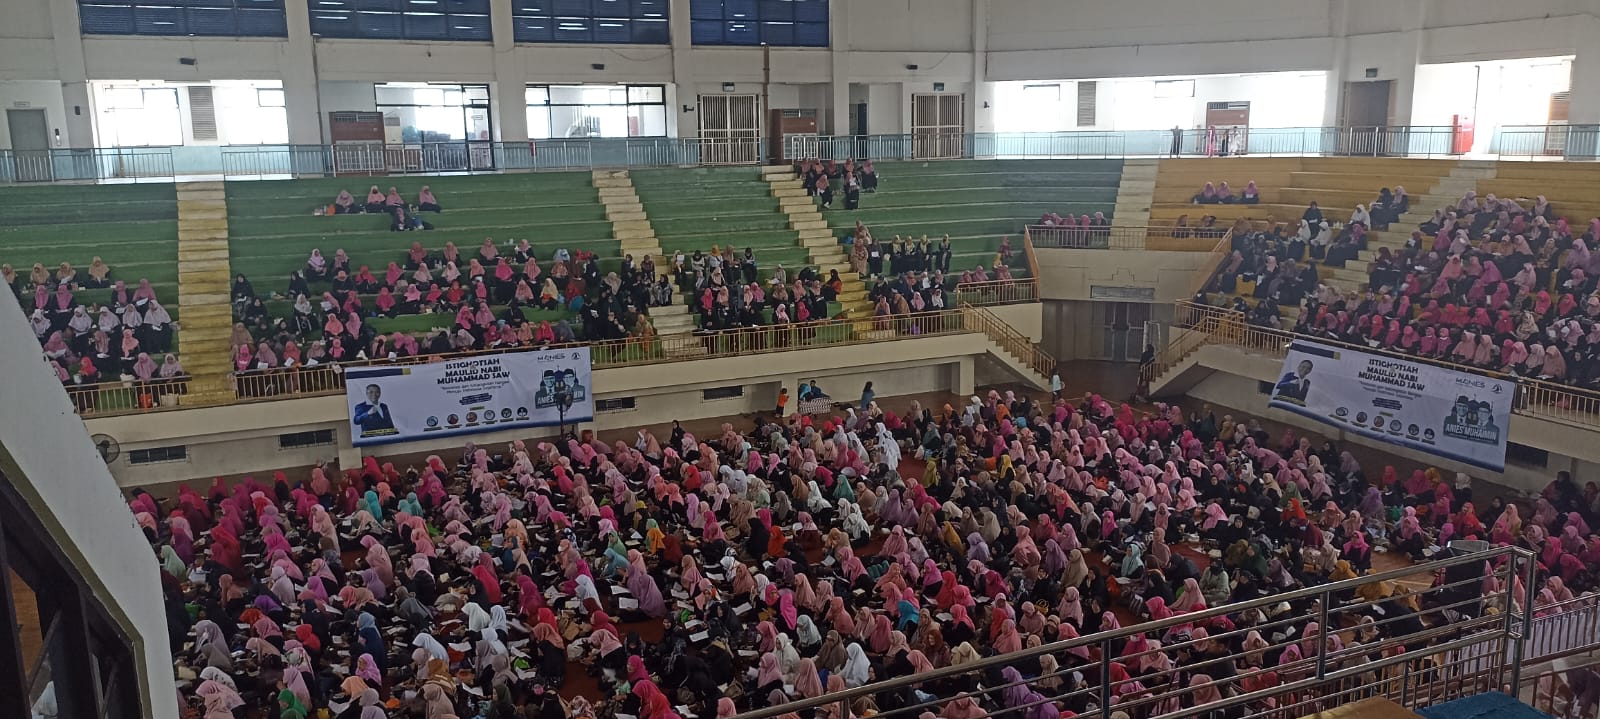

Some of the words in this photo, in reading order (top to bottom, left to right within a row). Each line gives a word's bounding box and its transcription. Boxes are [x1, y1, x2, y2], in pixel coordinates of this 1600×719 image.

[437, 373, 490, 384] MUHAMMAD
[492, 371, 510, 379] SAW
[445, 369, 479, 377] MAULID
[481, 366, 502, 374] NABI
[1367, 366, 1397, 378] MAULID
[1398, 372, 1419, 382] NABI
[1358, 371, 1406, 387] MUHAMMAD
[1445, 423, 1463, 434] ANIES
